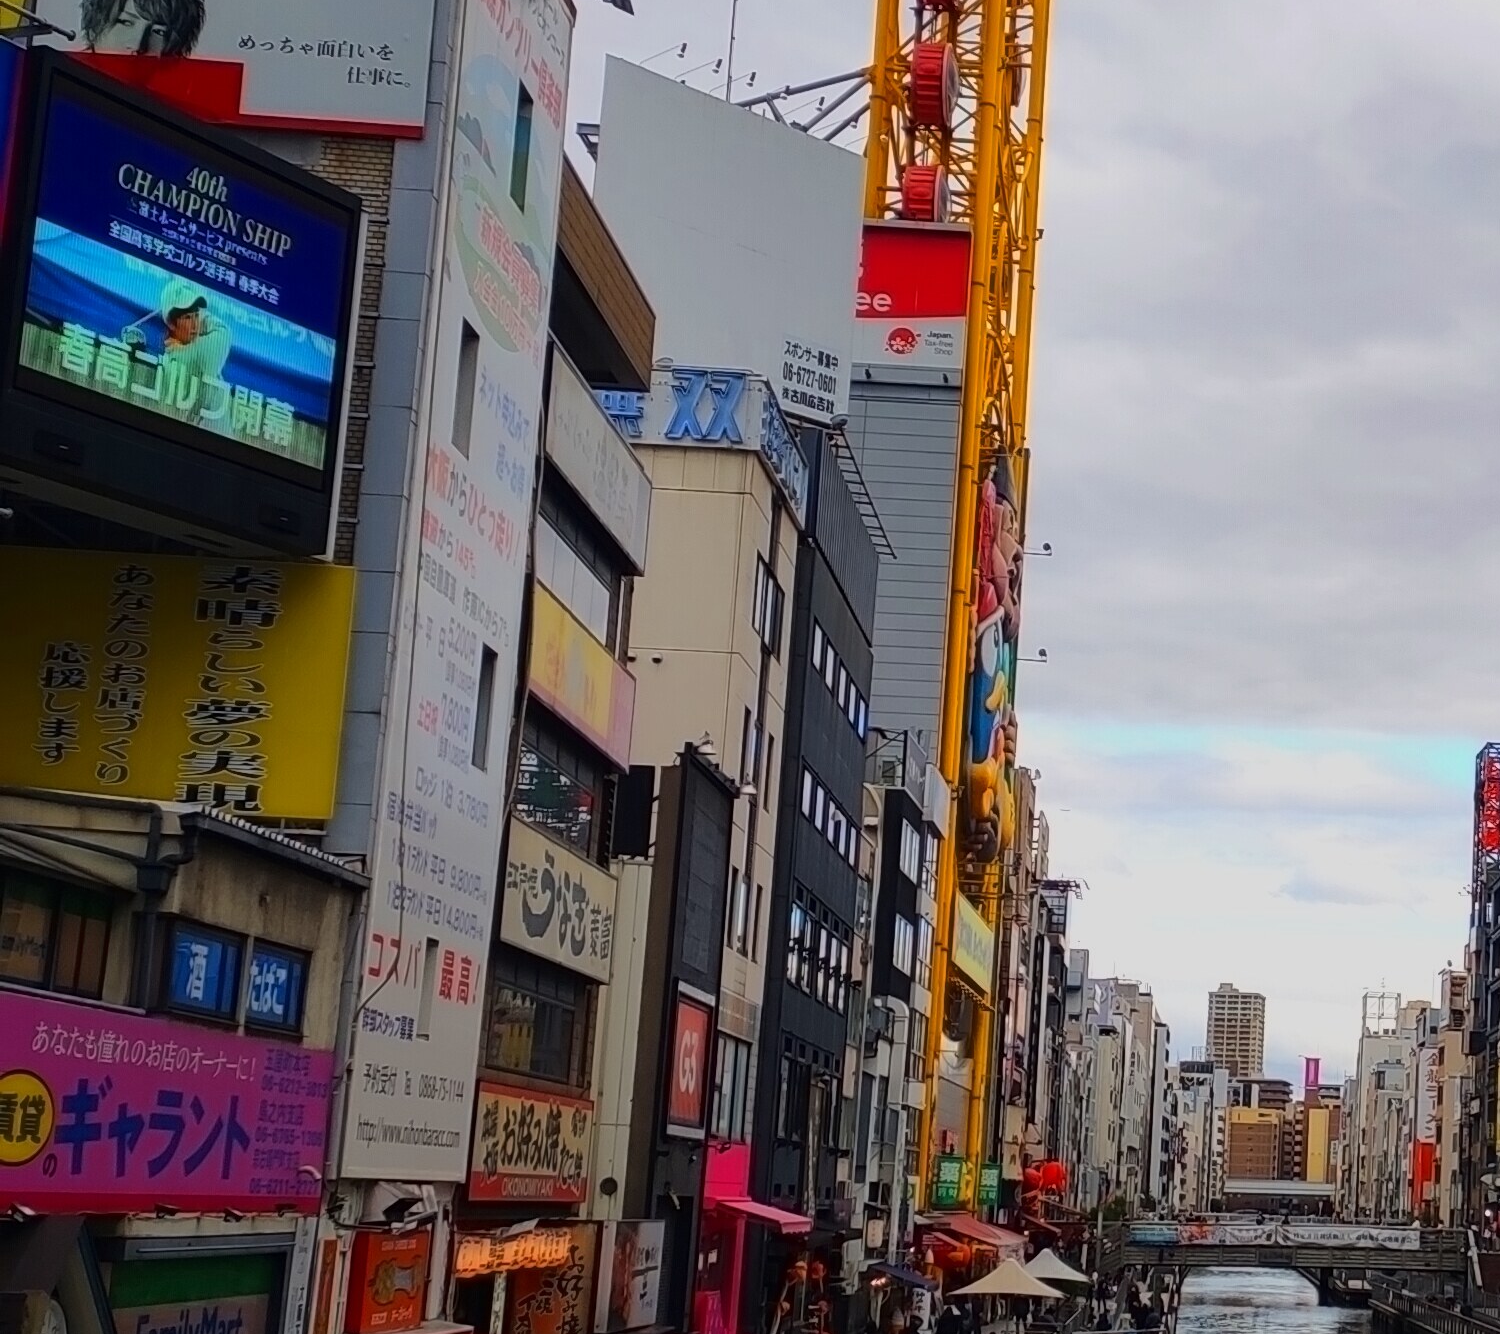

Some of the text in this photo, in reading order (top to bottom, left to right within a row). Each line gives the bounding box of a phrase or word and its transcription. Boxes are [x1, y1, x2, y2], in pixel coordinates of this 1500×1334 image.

[238, 35, 395, 61] めっちゃ面白いを
[346, 66, 414, 89] 仕事に。
[118, 163, 241, 245] CHAMPION
[244, 218, 293, 260] SHIP
[185, 165, 229, 201] 40th
[57, 321, 296, 449] 春高ゴルフ開幕
[782, 360, 837, 395] 06-6727-0601
[783, 339, 840, 371] スポンサー募集中
[32, 641, 94, 767] 応援します
[93, 563, 156, 786] あなたのお店づくり
[174, 565, 285, 813] 素晴らしい夢の実現
[186, 941, 208, 1002] 酒
[247, 958, 288, 1016] たばこ
[32, 1020, 257, 1083] あなたも憧れのお店のオーナーに!
[678, 1028, 699, 1094] G3
[42, 1152, 58, 1178] の
[55, 1075, 251, 1180] ギャラント
